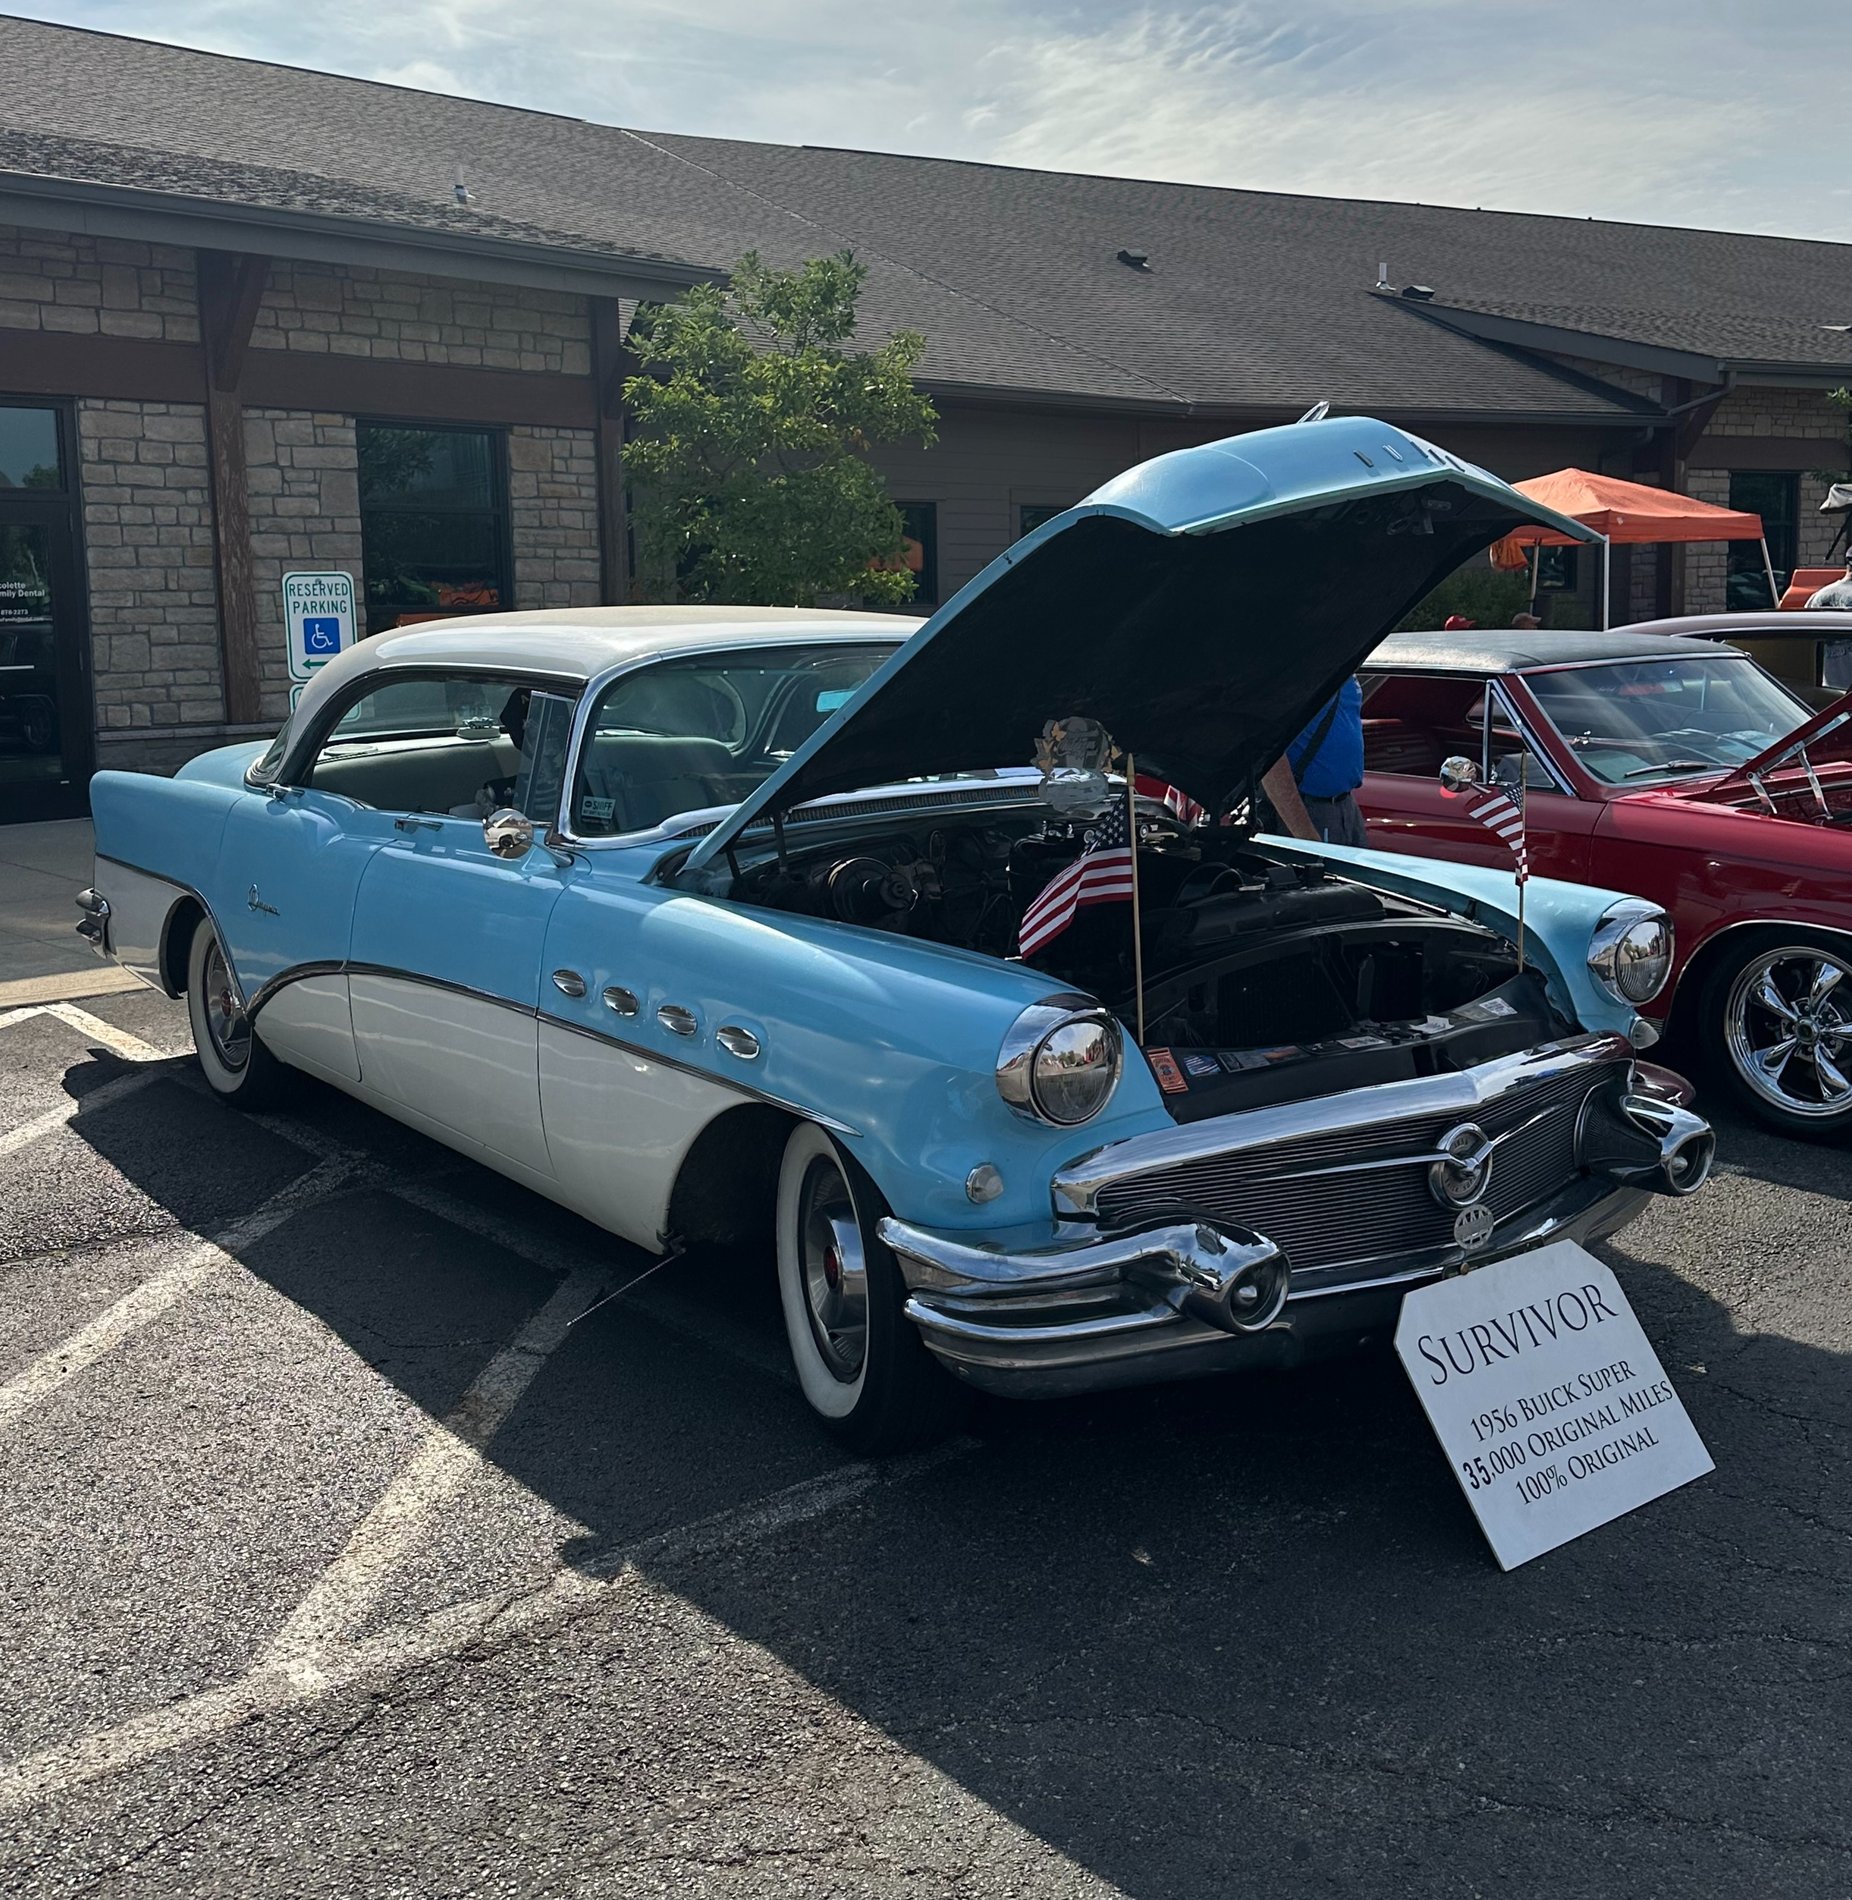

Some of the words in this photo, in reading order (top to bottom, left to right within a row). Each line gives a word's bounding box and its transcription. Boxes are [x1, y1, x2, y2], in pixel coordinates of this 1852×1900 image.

[18, 589, 45, 597] Dental
[289, 583, 348, 596] RESERVED
[293, 600, 347, 614] PARKING
[1418, 1284, 1619, 1385] SURVIVOR
[1463, 1441, 1525, 1490] 35,000
[1527, 1405, 1620, 1457] ORIGINAL
[1619, 1381, 1673, 1419] MILES
[1470, 1404, 1518, 1442] 1956
[1517, 1381, 1580, 1422] BUICK
[1577, 1360, 1636, 1396] SUPER
[1515, 1464, 1568, 1505] 100%
[1567, 1427, 1659, 1480] ORIGINAL
